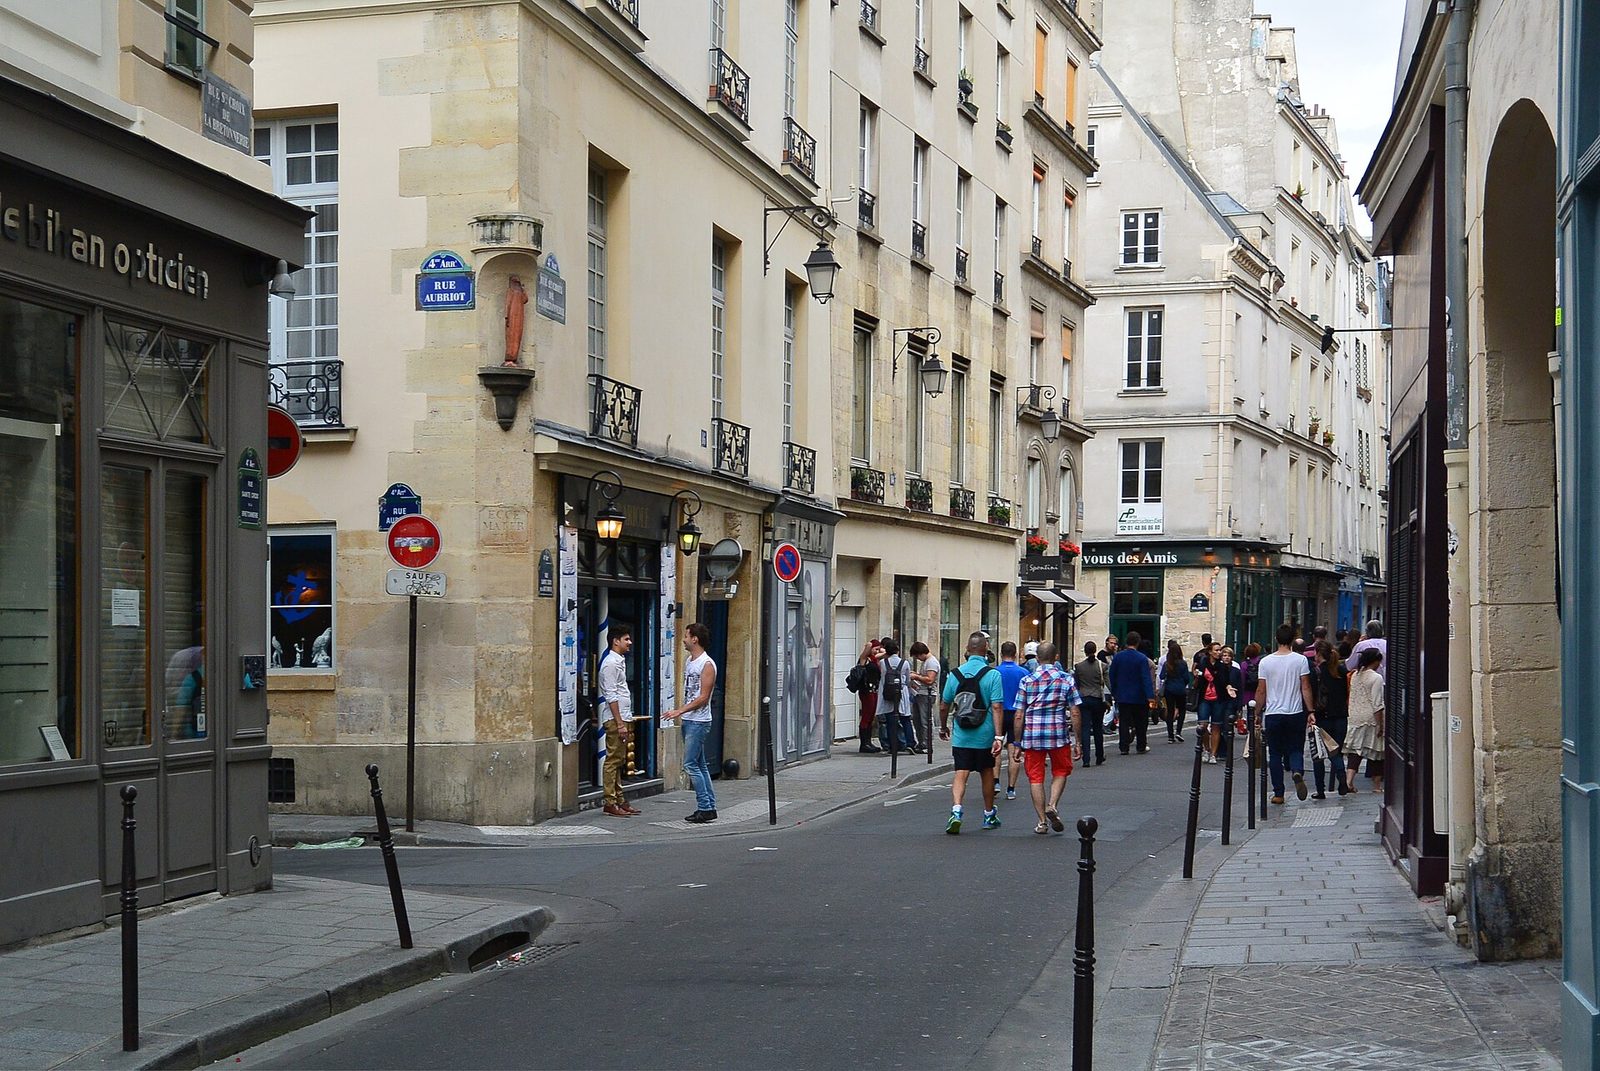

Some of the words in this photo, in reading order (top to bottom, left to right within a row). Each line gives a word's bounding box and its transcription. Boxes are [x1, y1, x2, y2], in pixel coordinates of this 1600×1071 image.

[222, 108, 231, 122] DE
[114, 242, 210, 300] opticien
[434, 280, 456, 290] RUE
[424, 292, 466, 302] AUBRIOT
[392, 507, 407, 515] RUE
[1117, 552, 1139, 564] des
[1142, 552, 1178, 564] Amis
